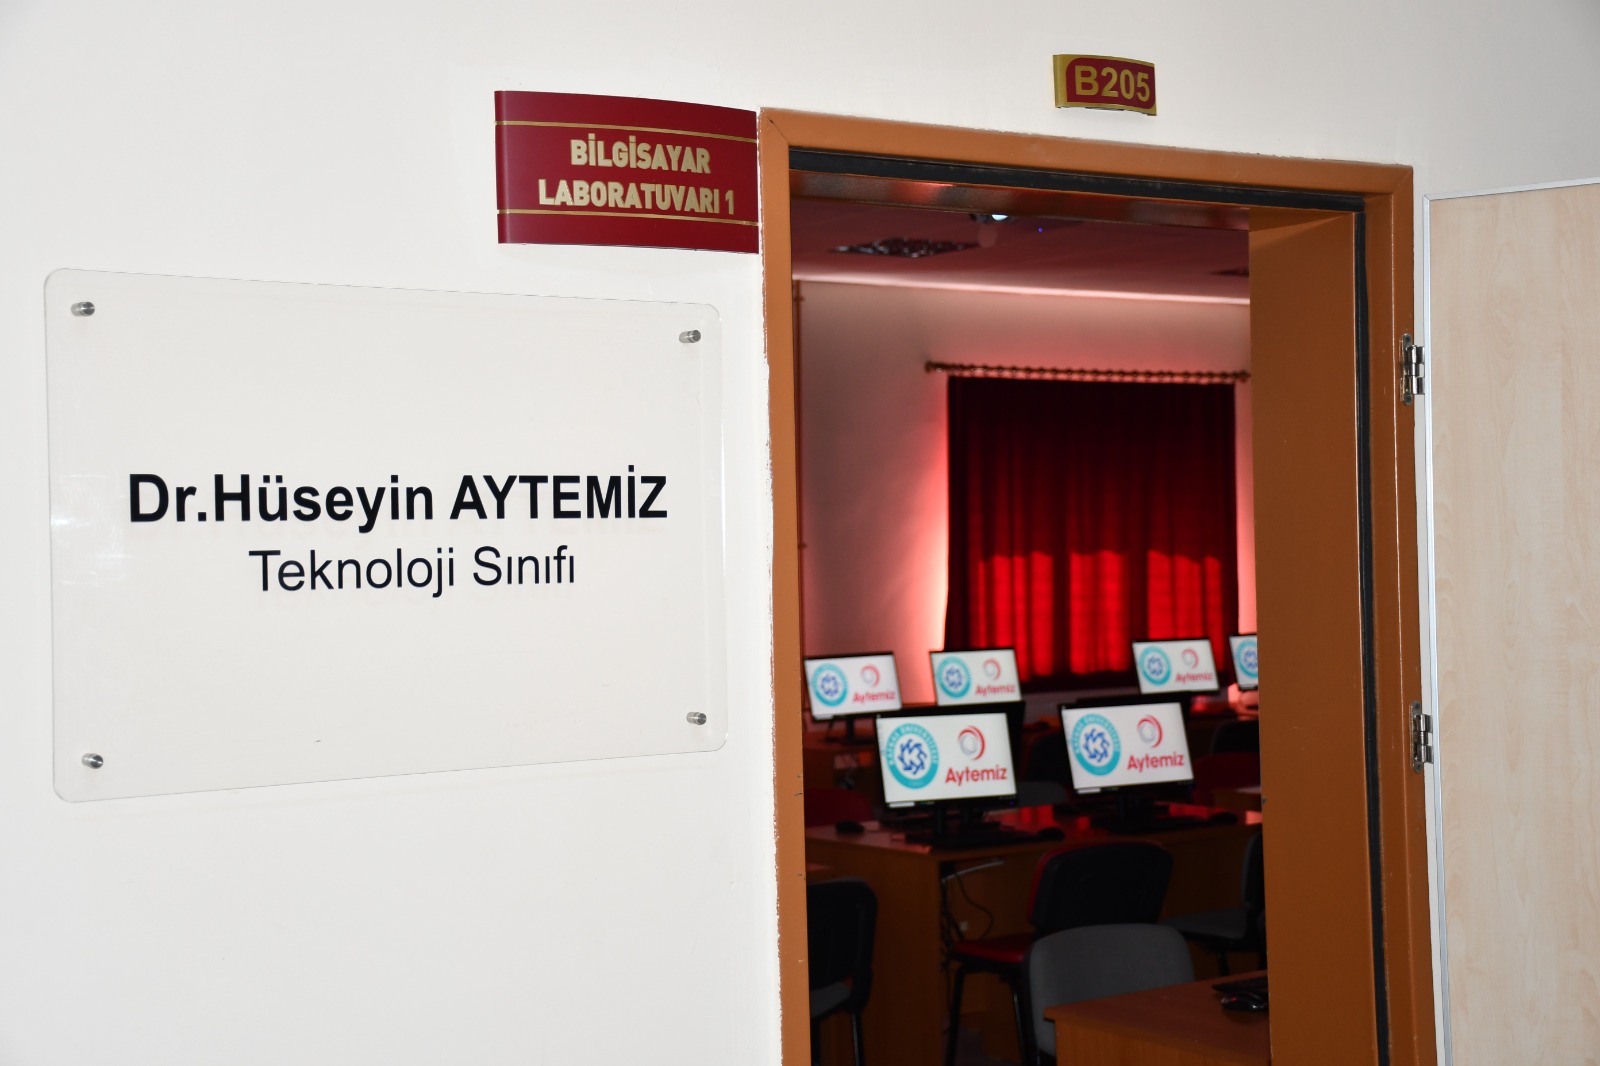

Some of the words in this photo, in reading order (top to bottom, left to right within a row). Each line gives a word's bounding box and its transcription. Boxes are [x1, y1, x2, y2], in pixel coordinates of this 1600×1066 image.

[1074, 65, 1150, 102] B205
[570, 132, 711, 174] BİLGİSAYAR
[538, 178, 720, 214] LABORATUVARI
[725, 190, 735, 215] 1
[129, 473, 434, 533] Dr.Hüseyin
[449, 465, 668, 519] AYTEMİZ
[248, 547, 455, 598] Teknoloji
[472, 545, 575, 586] Sınıfı
[853, 690, 896, 704] Aytemiz
[975, 684, 1015, 696] Aytemiz
[945, 764, 1008, 786] Aytemiz
[1126, 751, 1185, 773] Aytemiz
